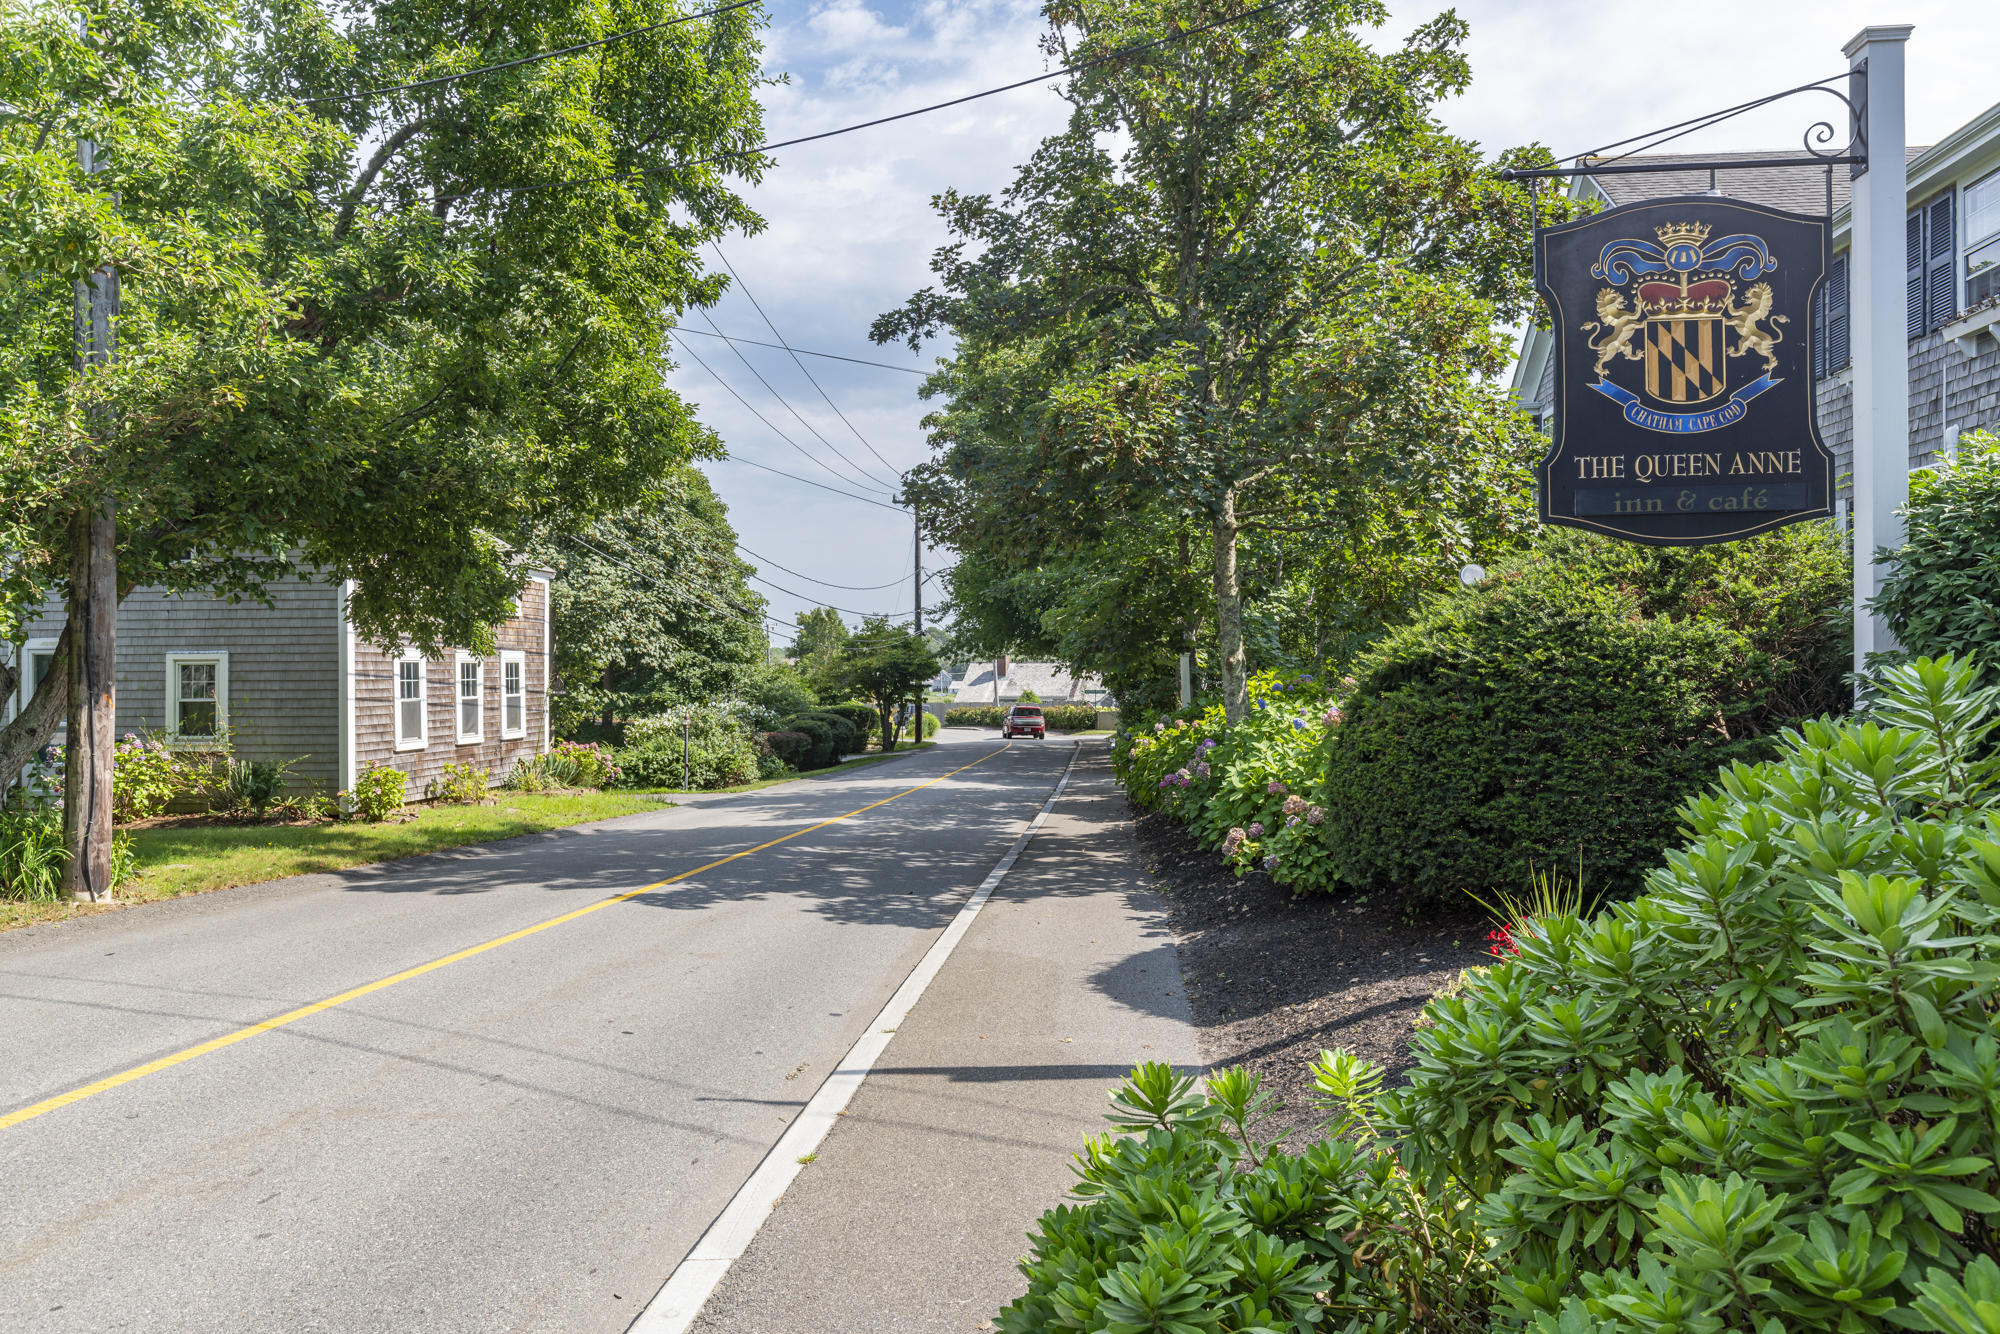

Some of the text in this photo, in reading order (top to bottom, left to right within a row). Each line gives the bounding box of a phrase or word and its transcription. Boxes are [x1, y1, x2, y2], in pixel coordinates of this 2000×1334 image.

[1631, 403, 1741, 431] CHATHAM CAPE COD
[1573, 450, 1802, 483] THE QUEEN ANNE
[1613, 487, 1769, 513] inn & café
